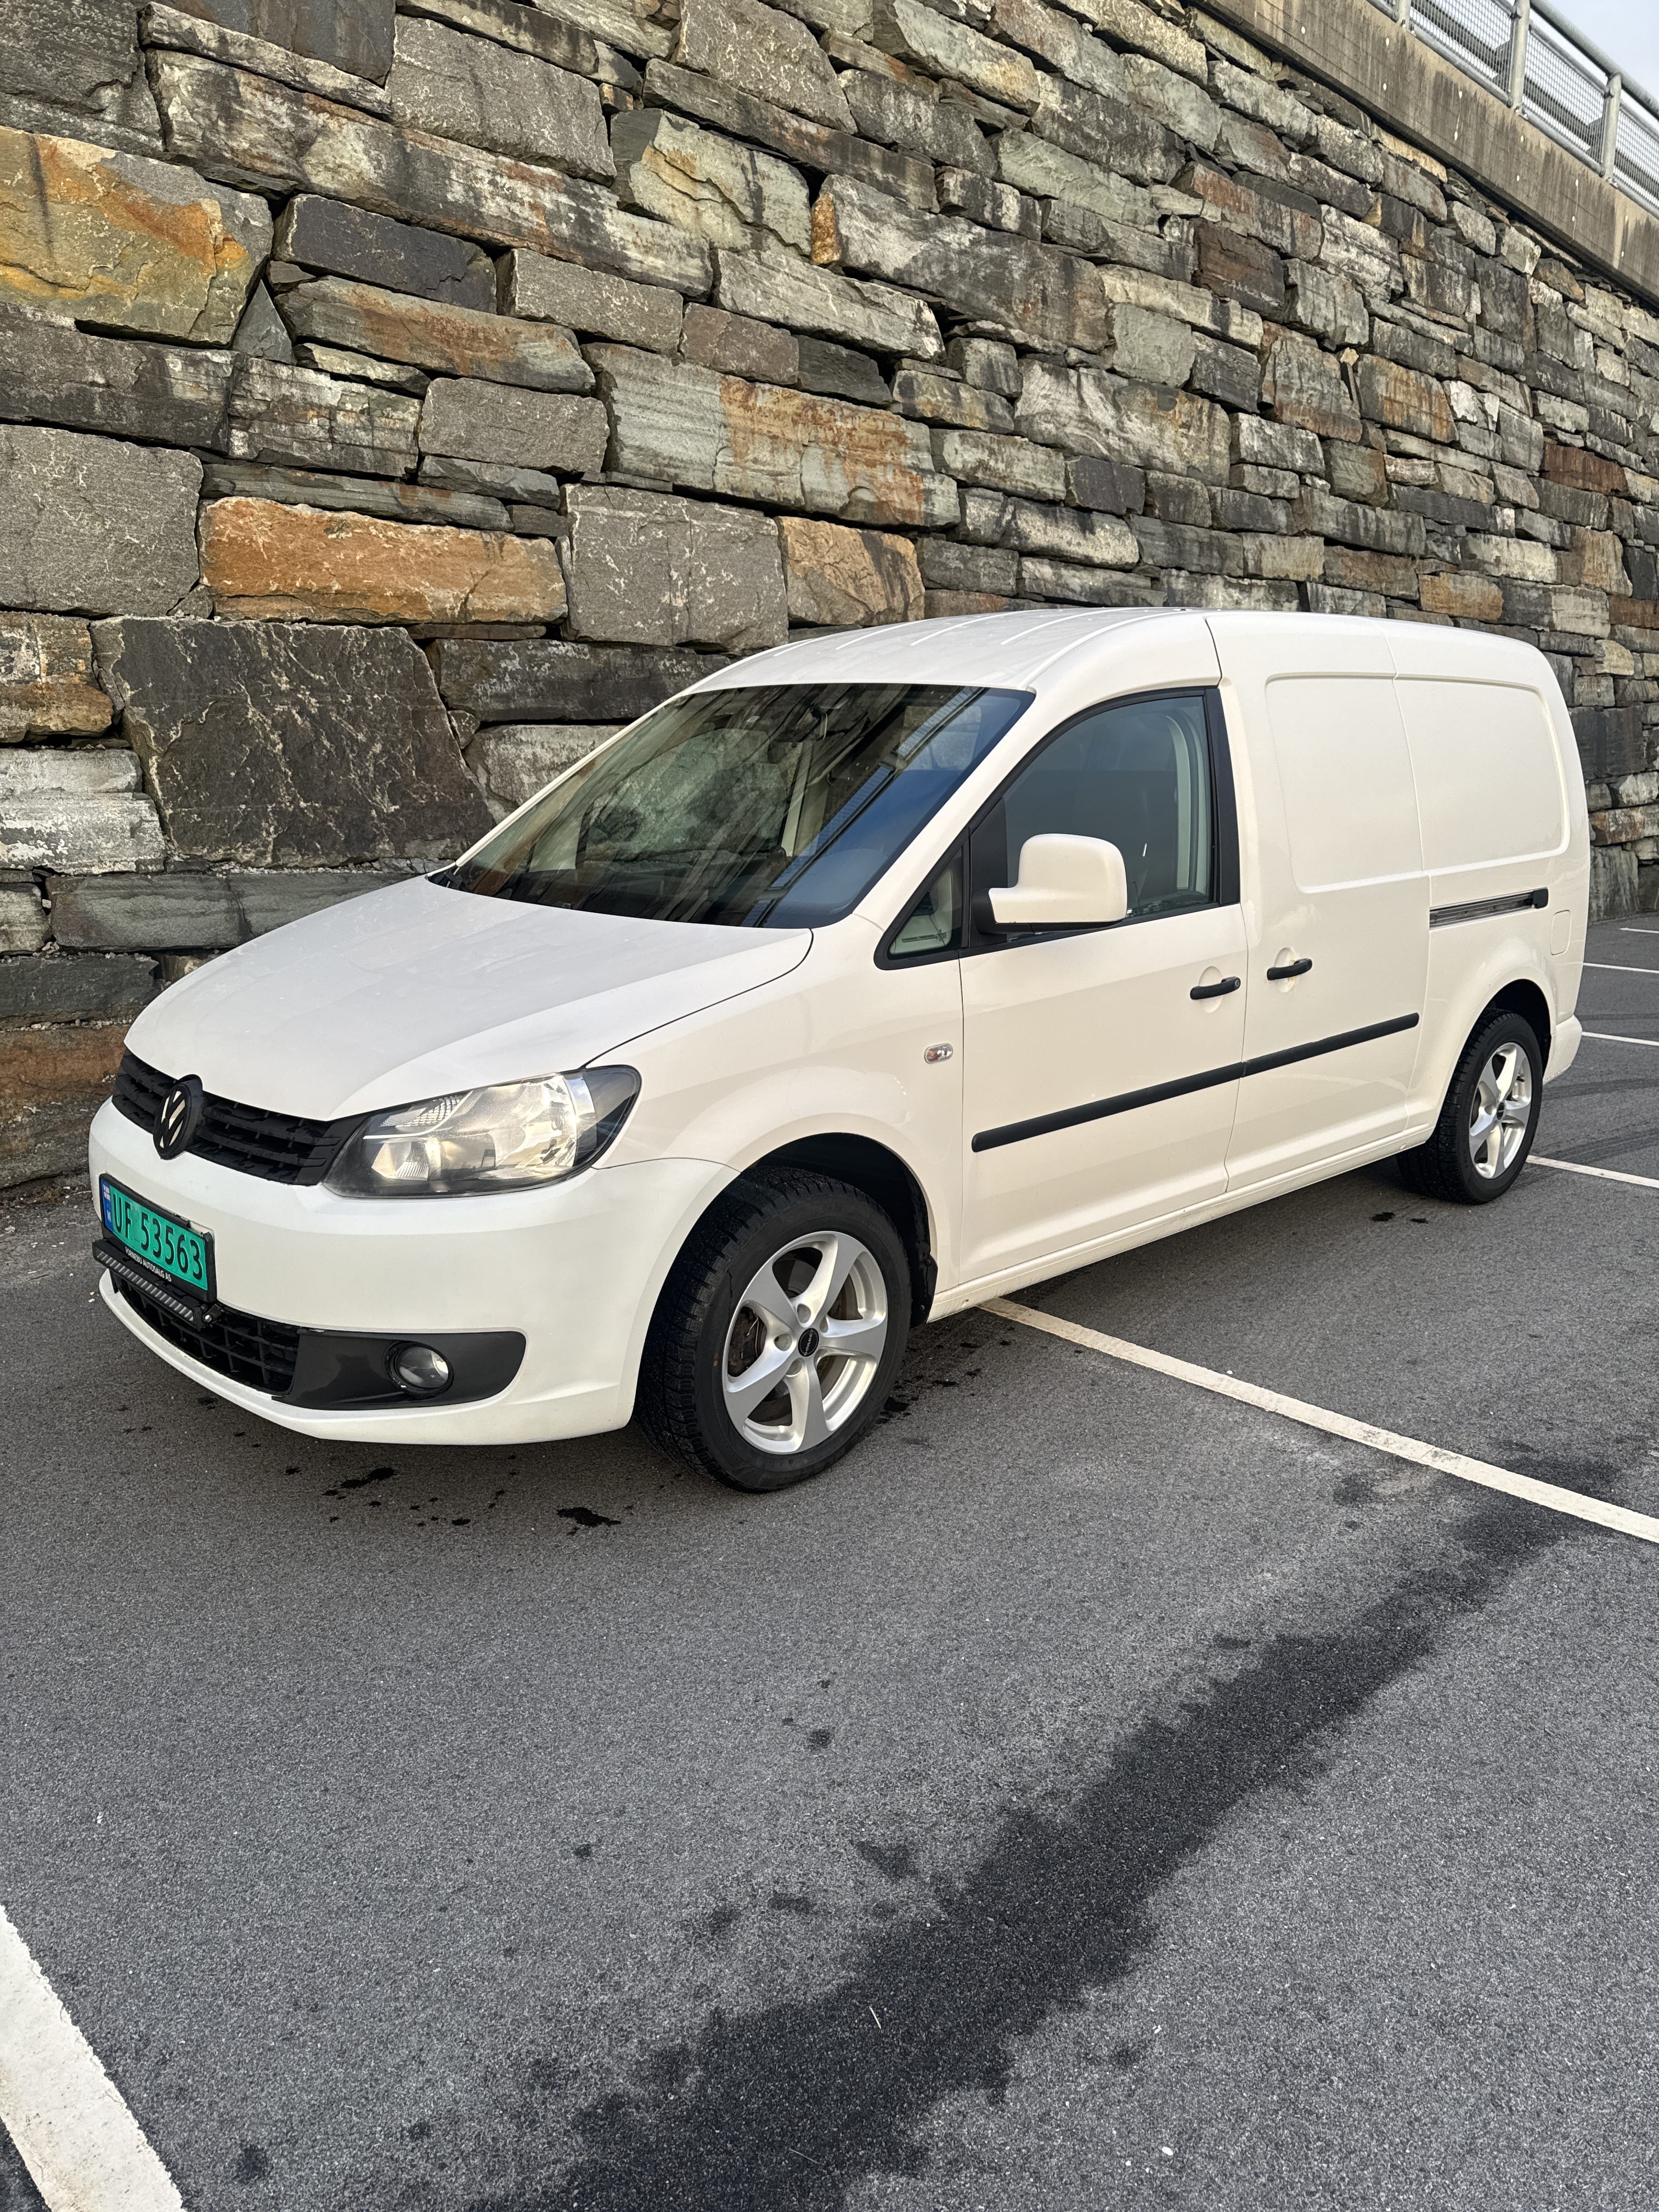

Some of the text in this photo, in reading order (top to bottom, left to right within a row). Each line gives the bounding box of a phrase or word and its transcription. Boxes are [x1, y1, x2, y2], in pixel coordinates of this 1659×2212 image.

[107, 1210, 111, 1222] N
[113, 1193, 203, 1280] UF 53563
[143, 1259, 165, 1278] AUTOSALG
[165, 1272, 172, 1282] AS
